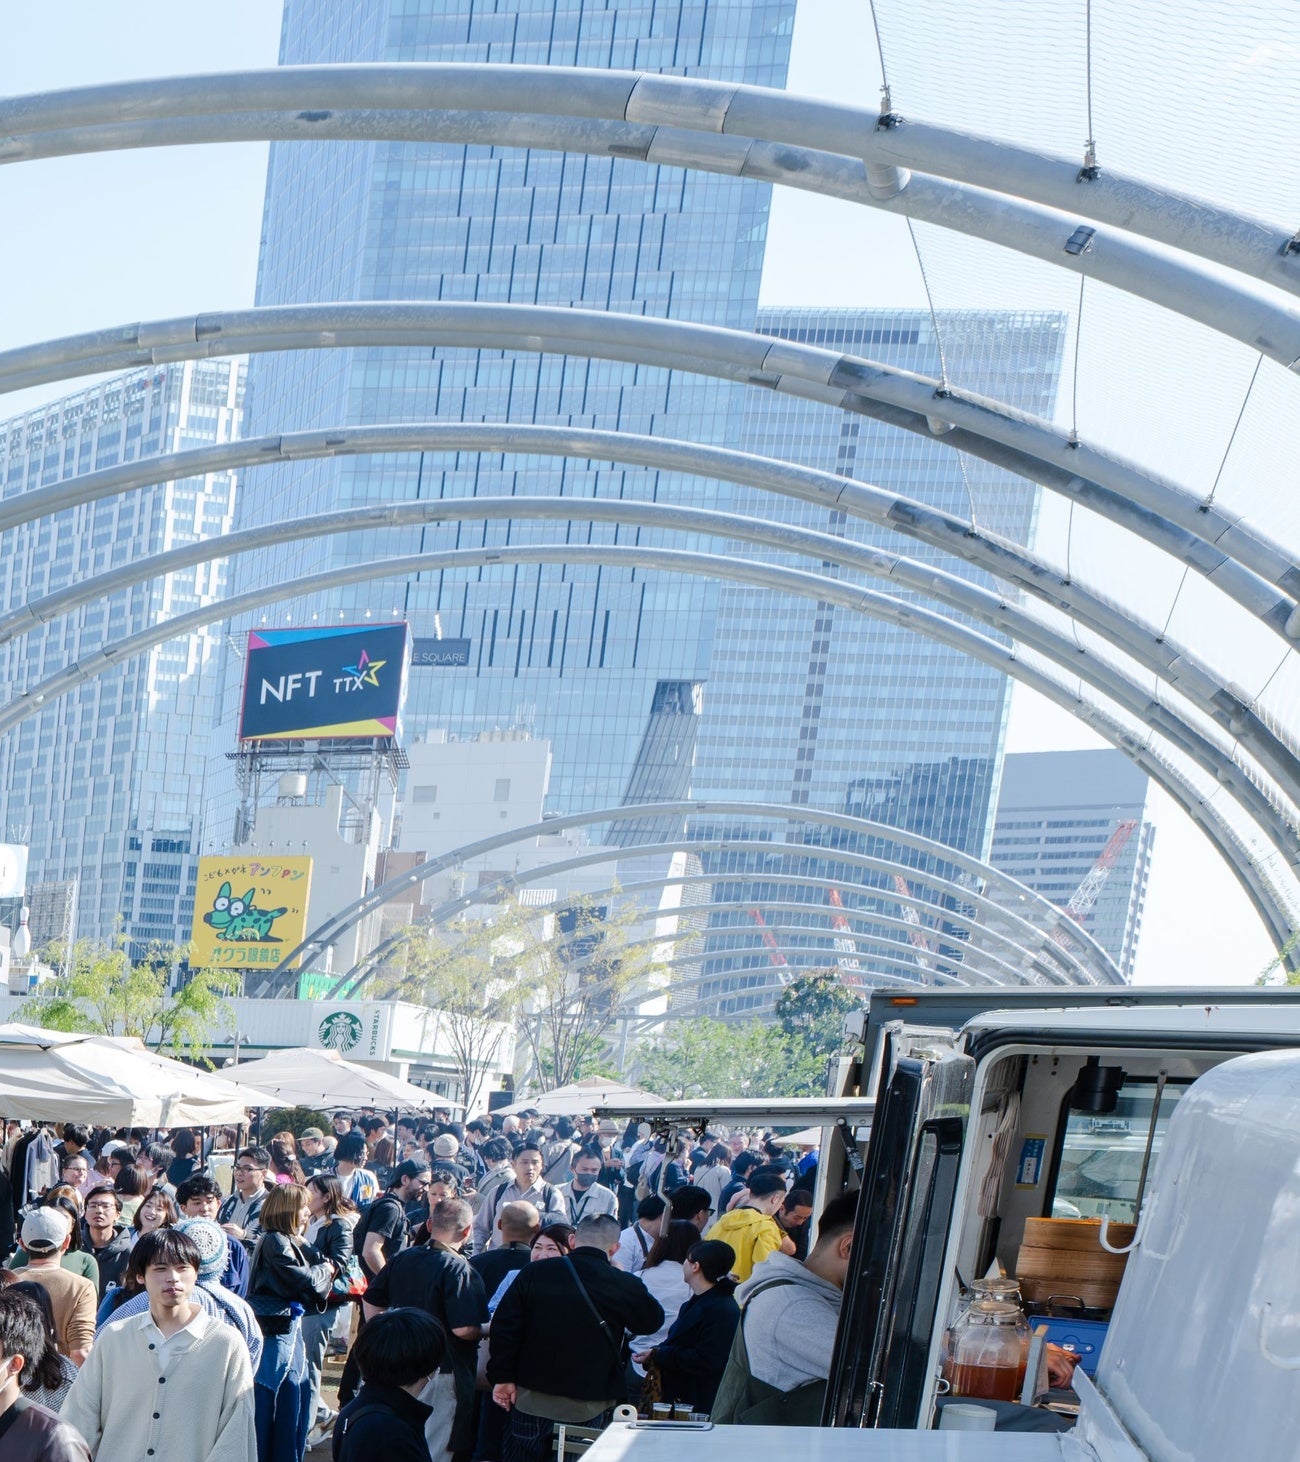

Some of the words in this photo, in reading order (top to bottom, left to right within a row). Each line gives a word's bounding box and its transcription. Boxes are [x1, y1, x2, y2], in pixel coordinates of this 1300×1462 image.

[422, 653, 466, 663] SQUARE
[260, 670, 323, 705] NFT
[333, 670, 367, 694] TTX
[369, 1009, 380, 1057] STARBUCKS
